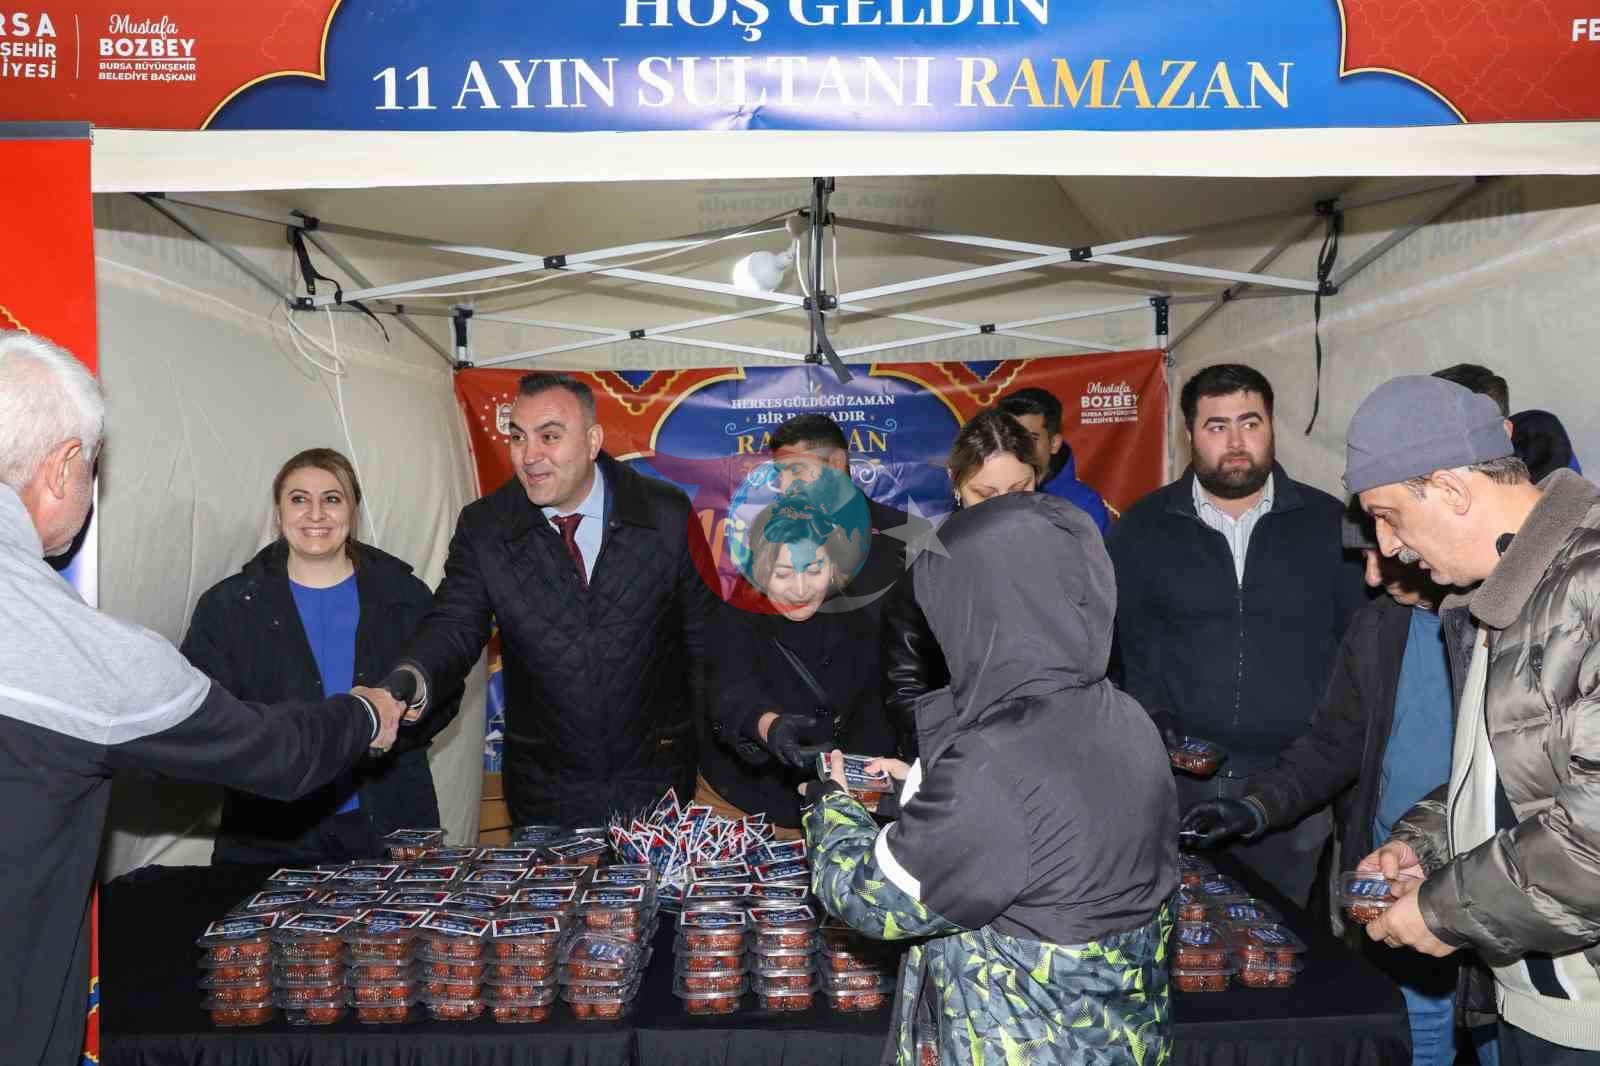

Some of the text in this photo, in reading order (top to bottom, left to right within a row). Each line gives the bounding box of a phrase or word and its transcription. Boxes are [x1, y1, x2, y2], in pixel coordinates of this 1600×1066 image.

[109, 13, 178, 40] Mustafa
[99, 38, 196, 57] BOZBEY
[99, 61, 196, 73] BURSA BÜYÜKŞEHİR
[98, 71, 196, 83] BELEDİYE BAŞKANI
[372, 55, 1294, 110] 11 AYIN SULTANI RAMAZAN
[731, 398, 782, 409] HERKES
[847, 394, 895, 406] ZAMAN
[1080, 394, 1139, 409] BOZBEY
[757, 409, 865, 427] BİR BADIR
[736, 428, 888, 455] RAAN
